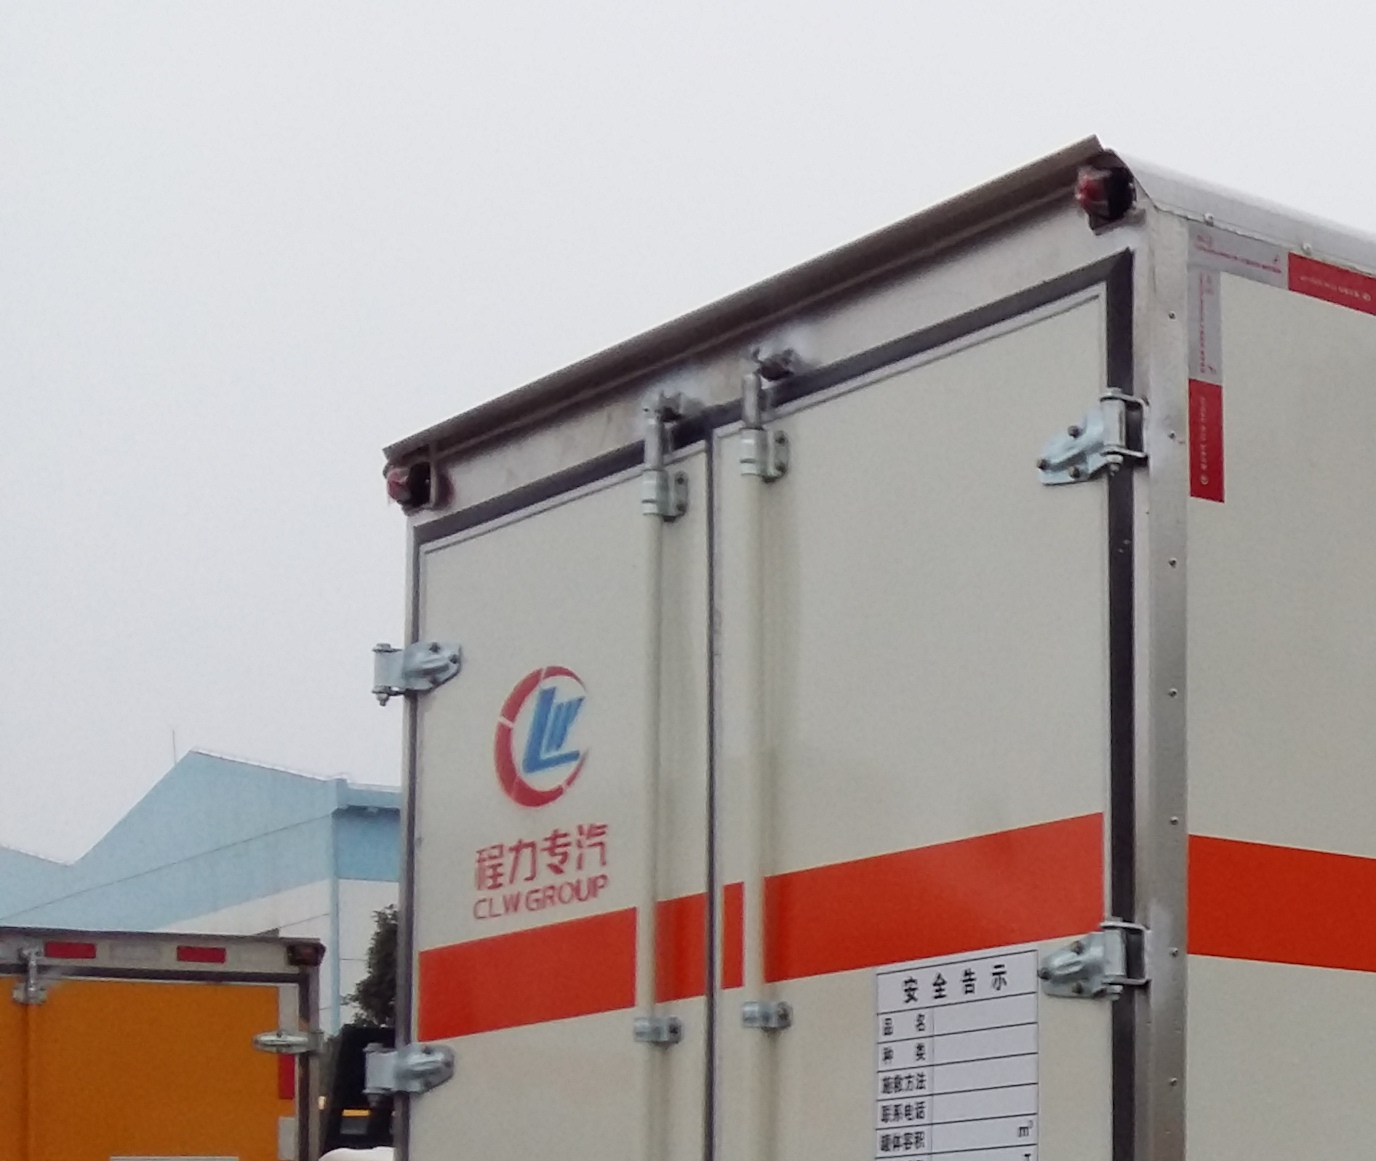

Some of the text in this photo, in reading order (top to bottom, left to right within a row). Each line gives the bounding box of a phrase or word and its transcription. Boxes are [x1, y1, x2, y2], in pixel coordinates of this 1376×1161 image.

[475, 823, 609, 891] 程力专汽
[903, 963, 1008, 1004] 安全告示
